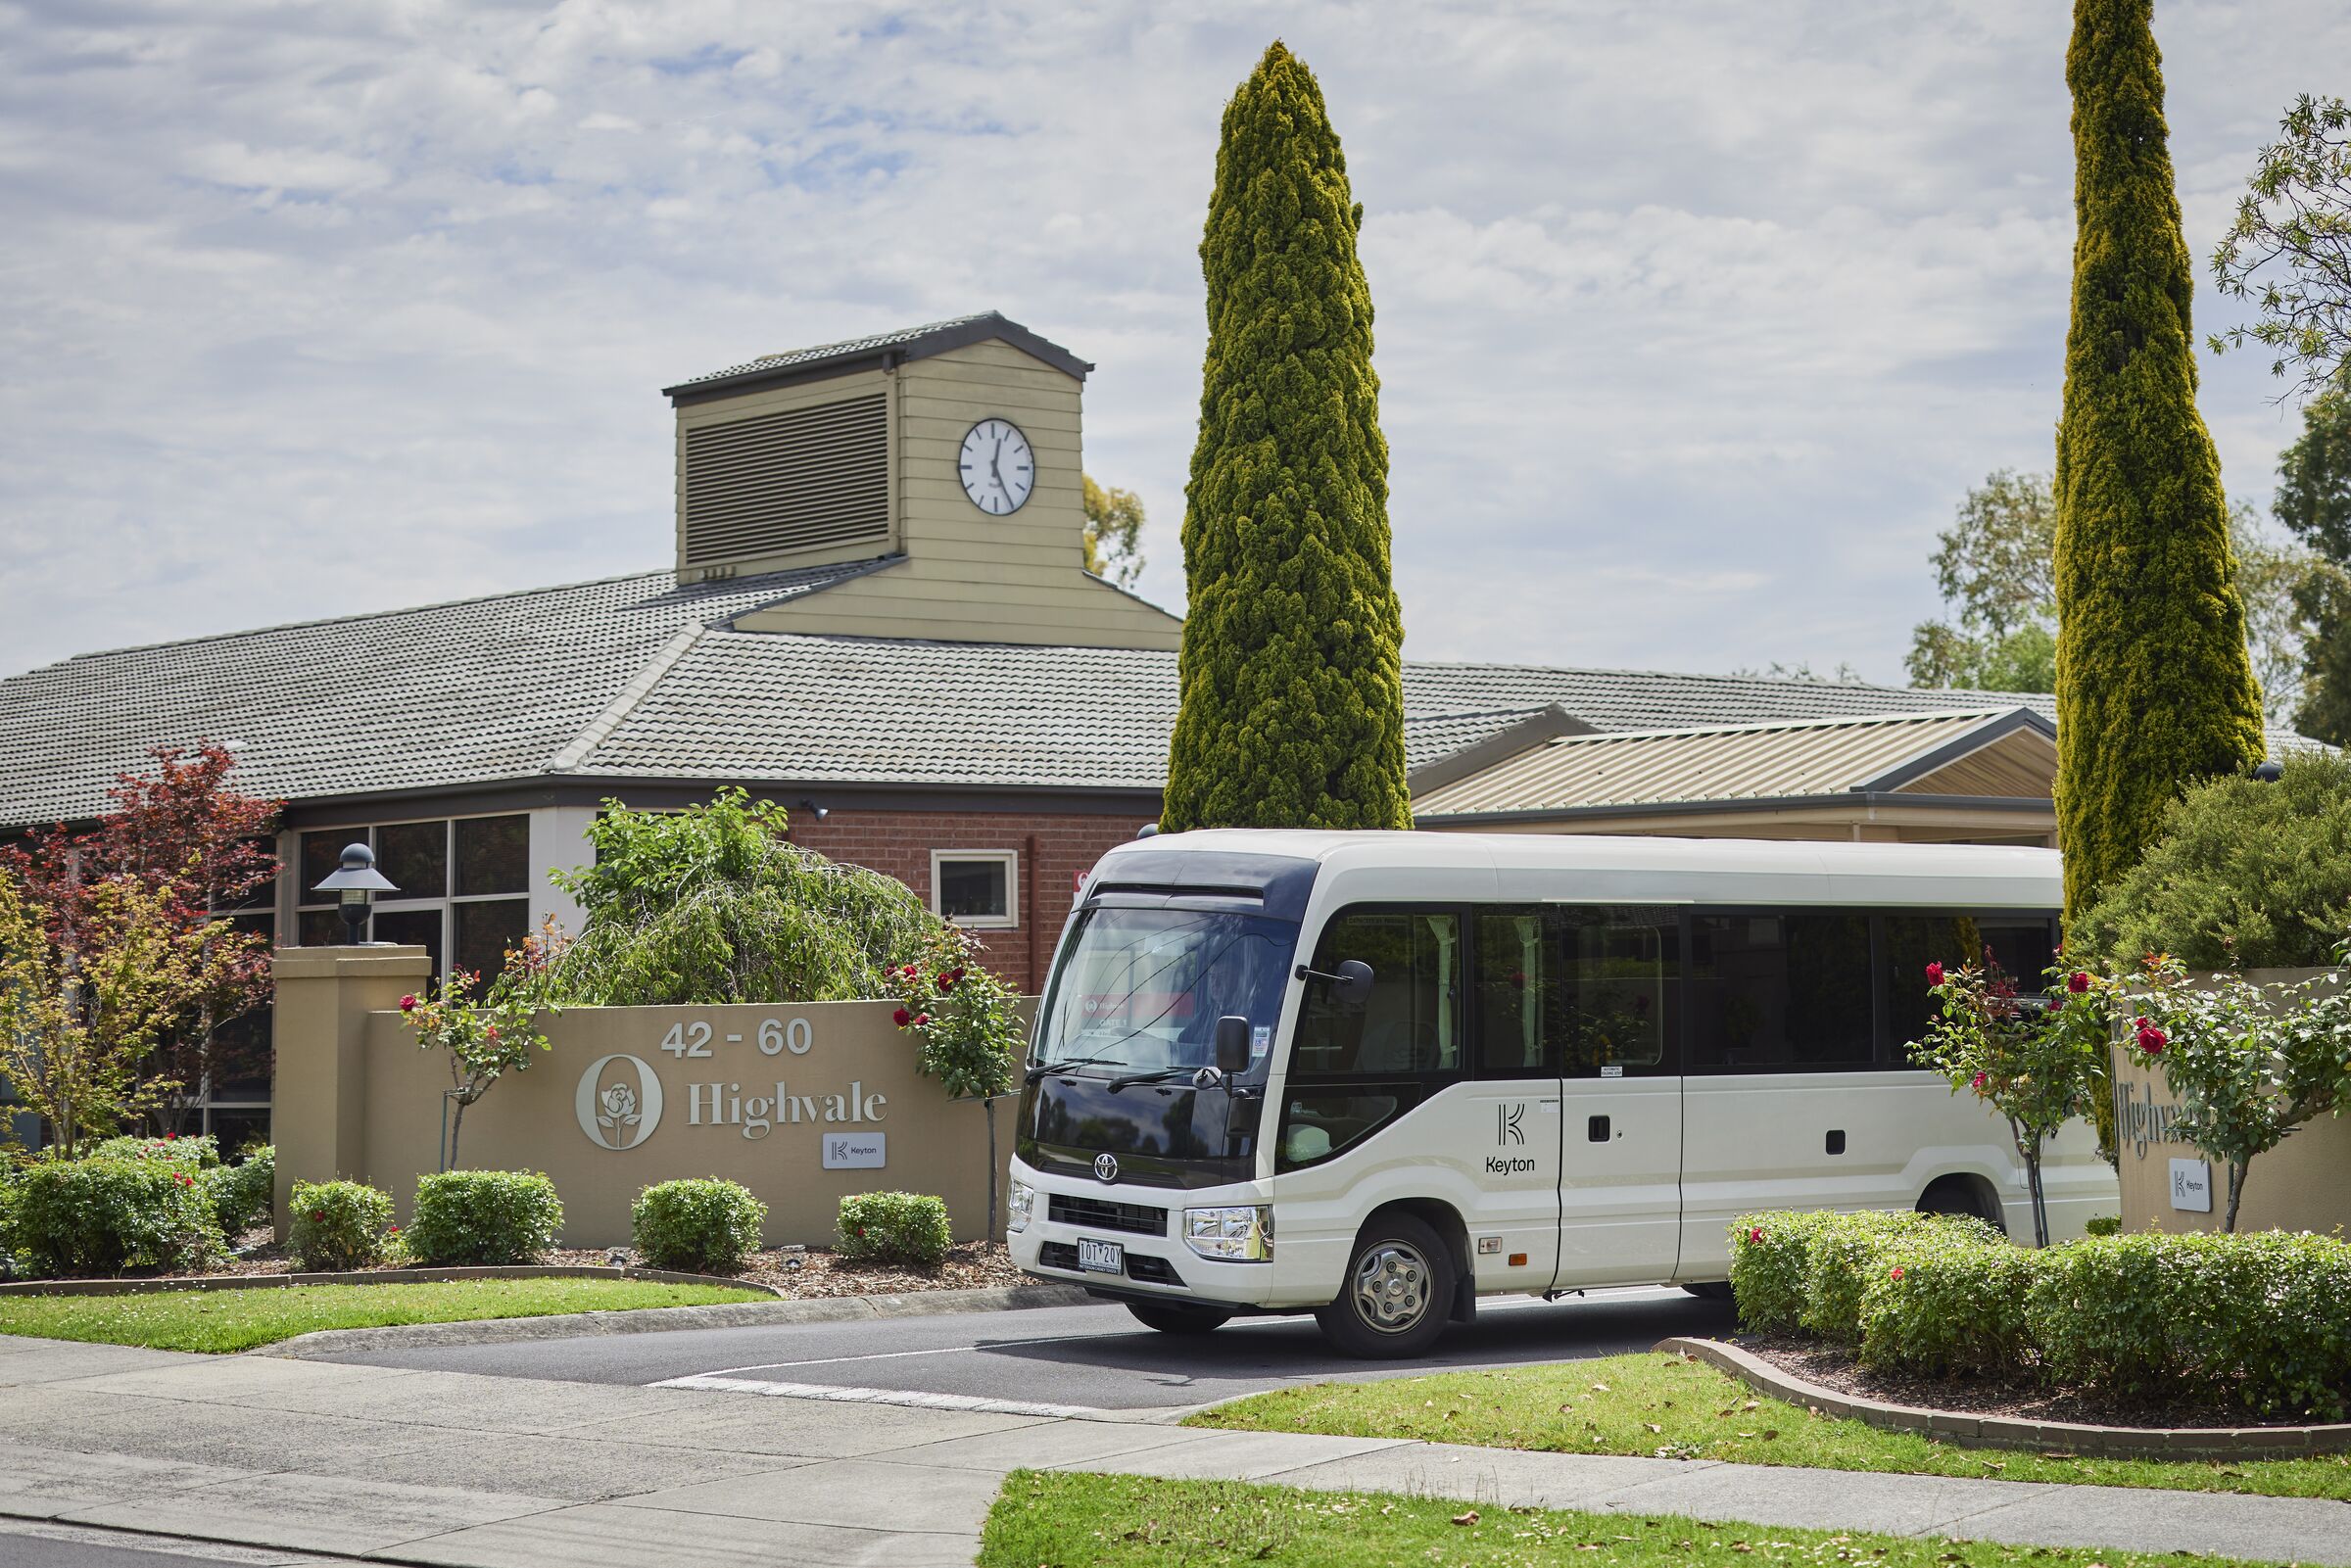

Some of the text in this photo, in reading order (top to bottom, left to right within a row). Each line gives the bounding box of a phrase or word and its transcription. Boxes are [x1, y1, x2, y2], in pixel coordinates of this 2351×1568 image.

[661, 1021, 713, 1059] 42
[757, 1018, 813, 1056] 60
[687, 1080, 888, 1140] Highvale
[850, 1147, 877, 1156] Keyton
[1486, 1156, 1535, 1176] Keyton
[2185, 1179, 2203, 1192] Keyton
